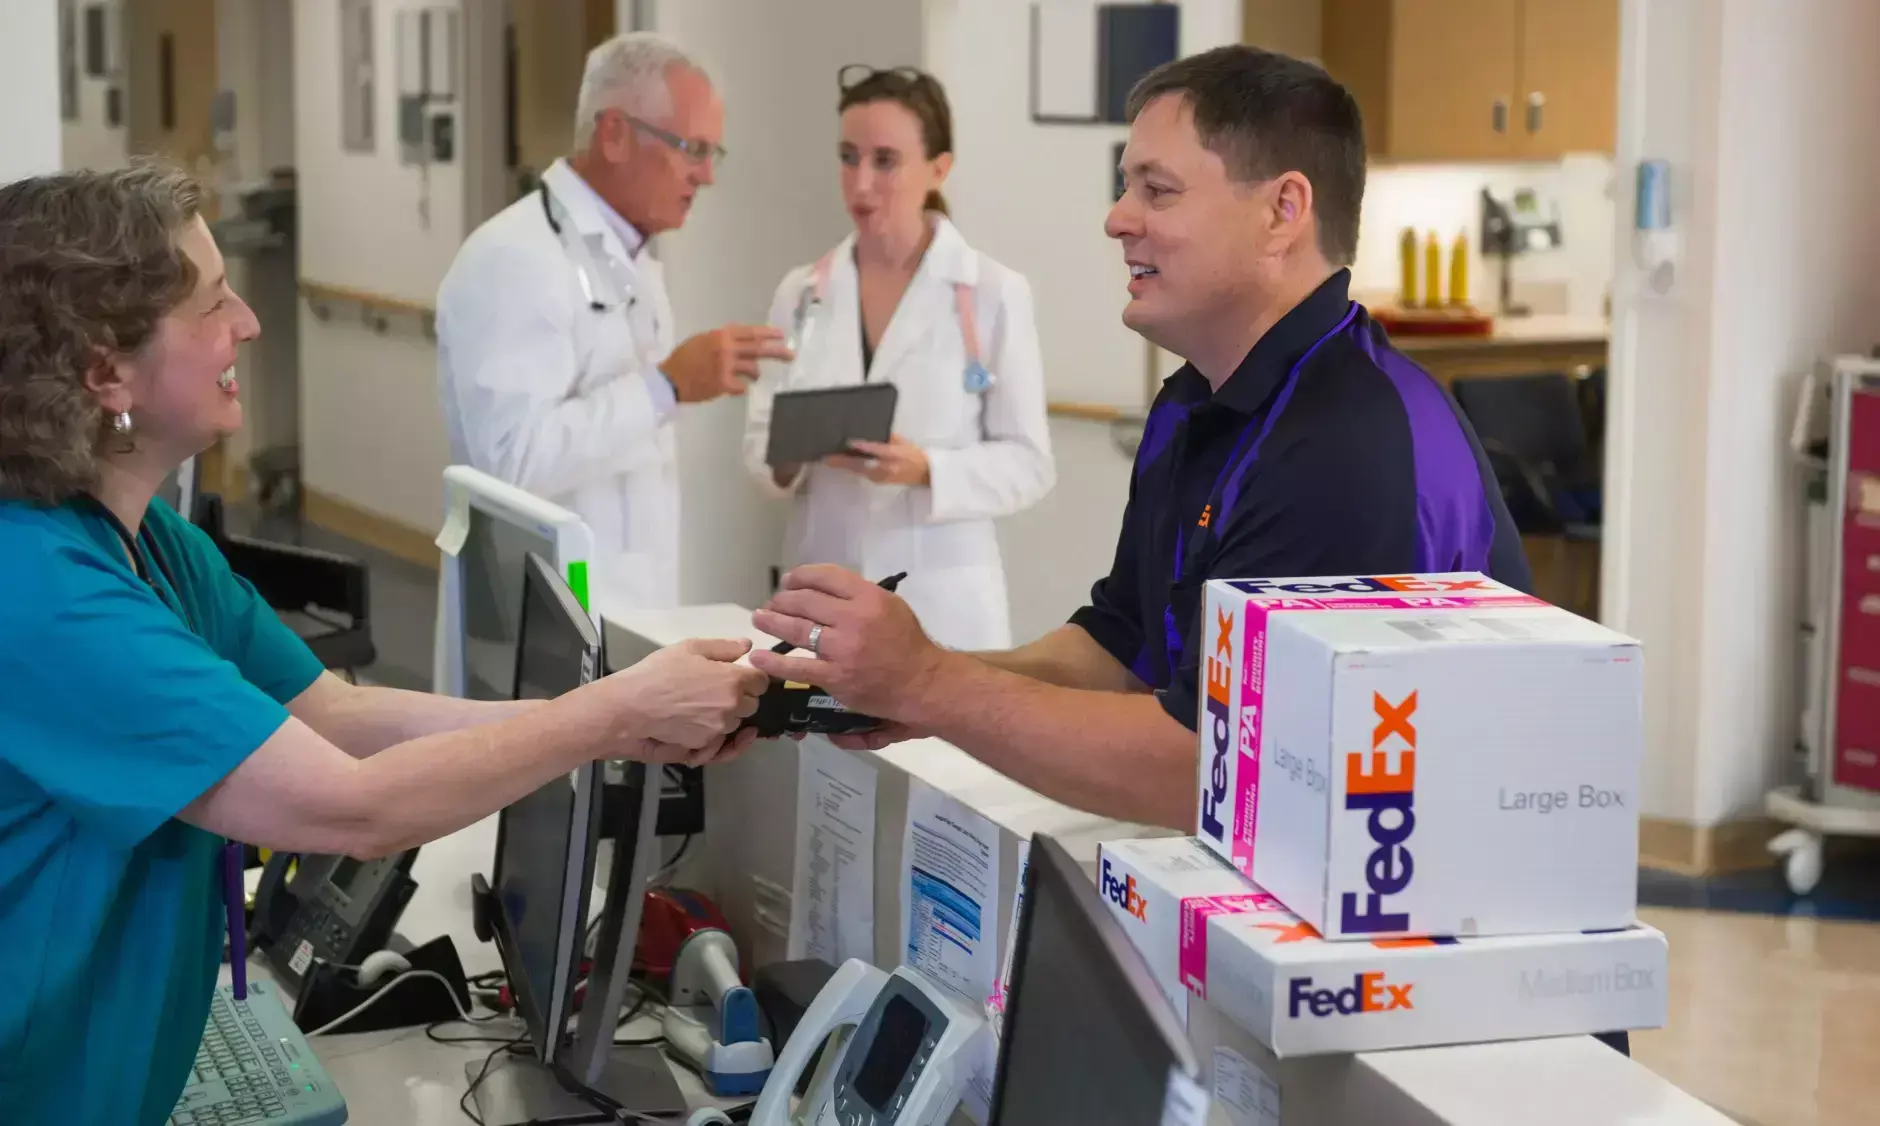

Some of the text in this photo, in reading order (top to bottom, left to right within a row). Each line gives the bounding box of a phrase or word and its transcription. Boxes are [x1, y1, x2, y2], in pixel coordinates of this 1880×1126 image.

[1224, 575, 1500, 595] FedEx
[1202, 602, 1234, 844] FedEx
[1240, 705, 1258, 761] PA
[1273, 737, 1329, 792] Large Bo
[1341, 688, 1418, 934] FedEx
[1498, 784, 1626, 814] Large Box
[1102, 859, 1148, 923] FedEx
[1289, 971, 1415, 1018] FedEx
[1518, 962, 1655, 1000] Medium Box
